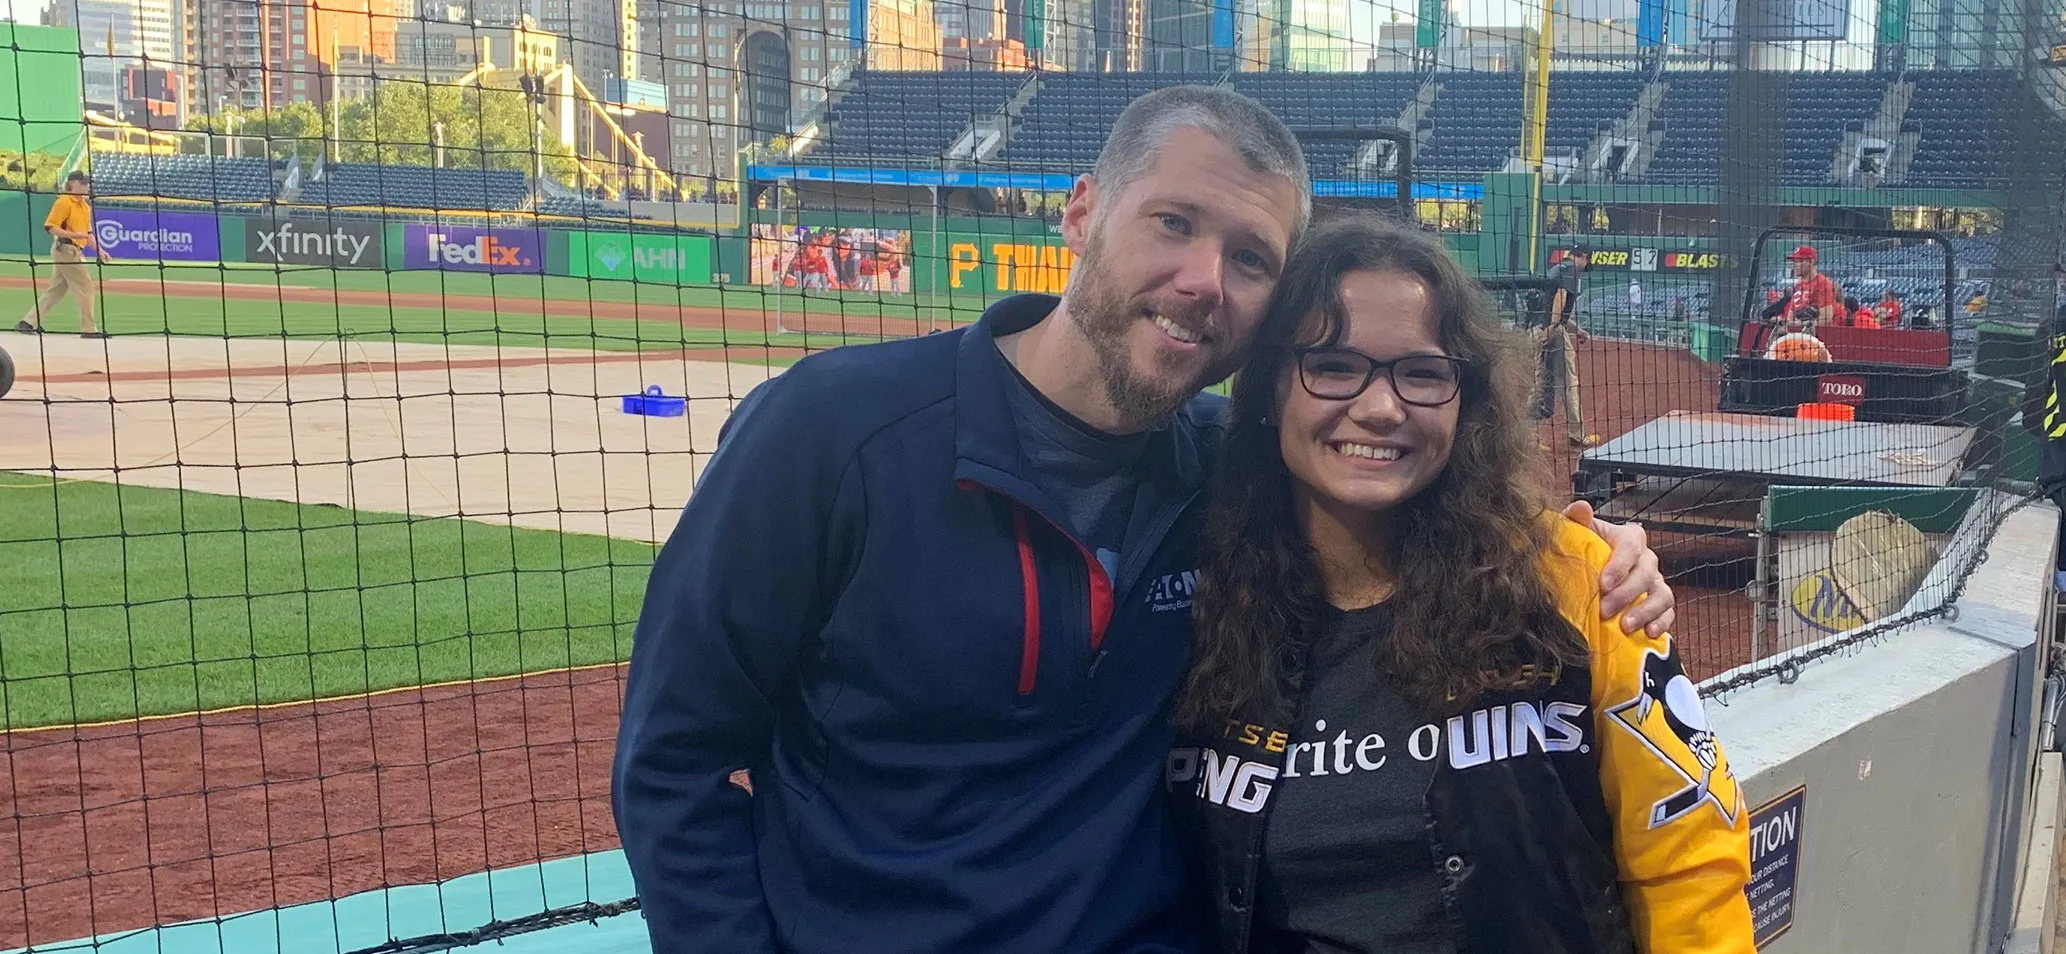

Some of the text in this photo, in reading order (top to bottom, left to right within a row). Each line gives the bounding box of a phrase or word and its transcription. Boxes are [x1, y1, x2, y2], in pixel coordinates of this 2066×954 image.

[100, 224, 192, 244] Guardian
[256, 222, 371, 265] xfinity
[138, 242, 192, 253] PROTECTION
[634, 246, 686, 270] AHN
[951, 243, 979, 288] P
[1822, 382, 1863, 397] TORO
[1763, 854, 1789, 877] DISTANCE
[1768, 887, 1791, 907] NETTING
